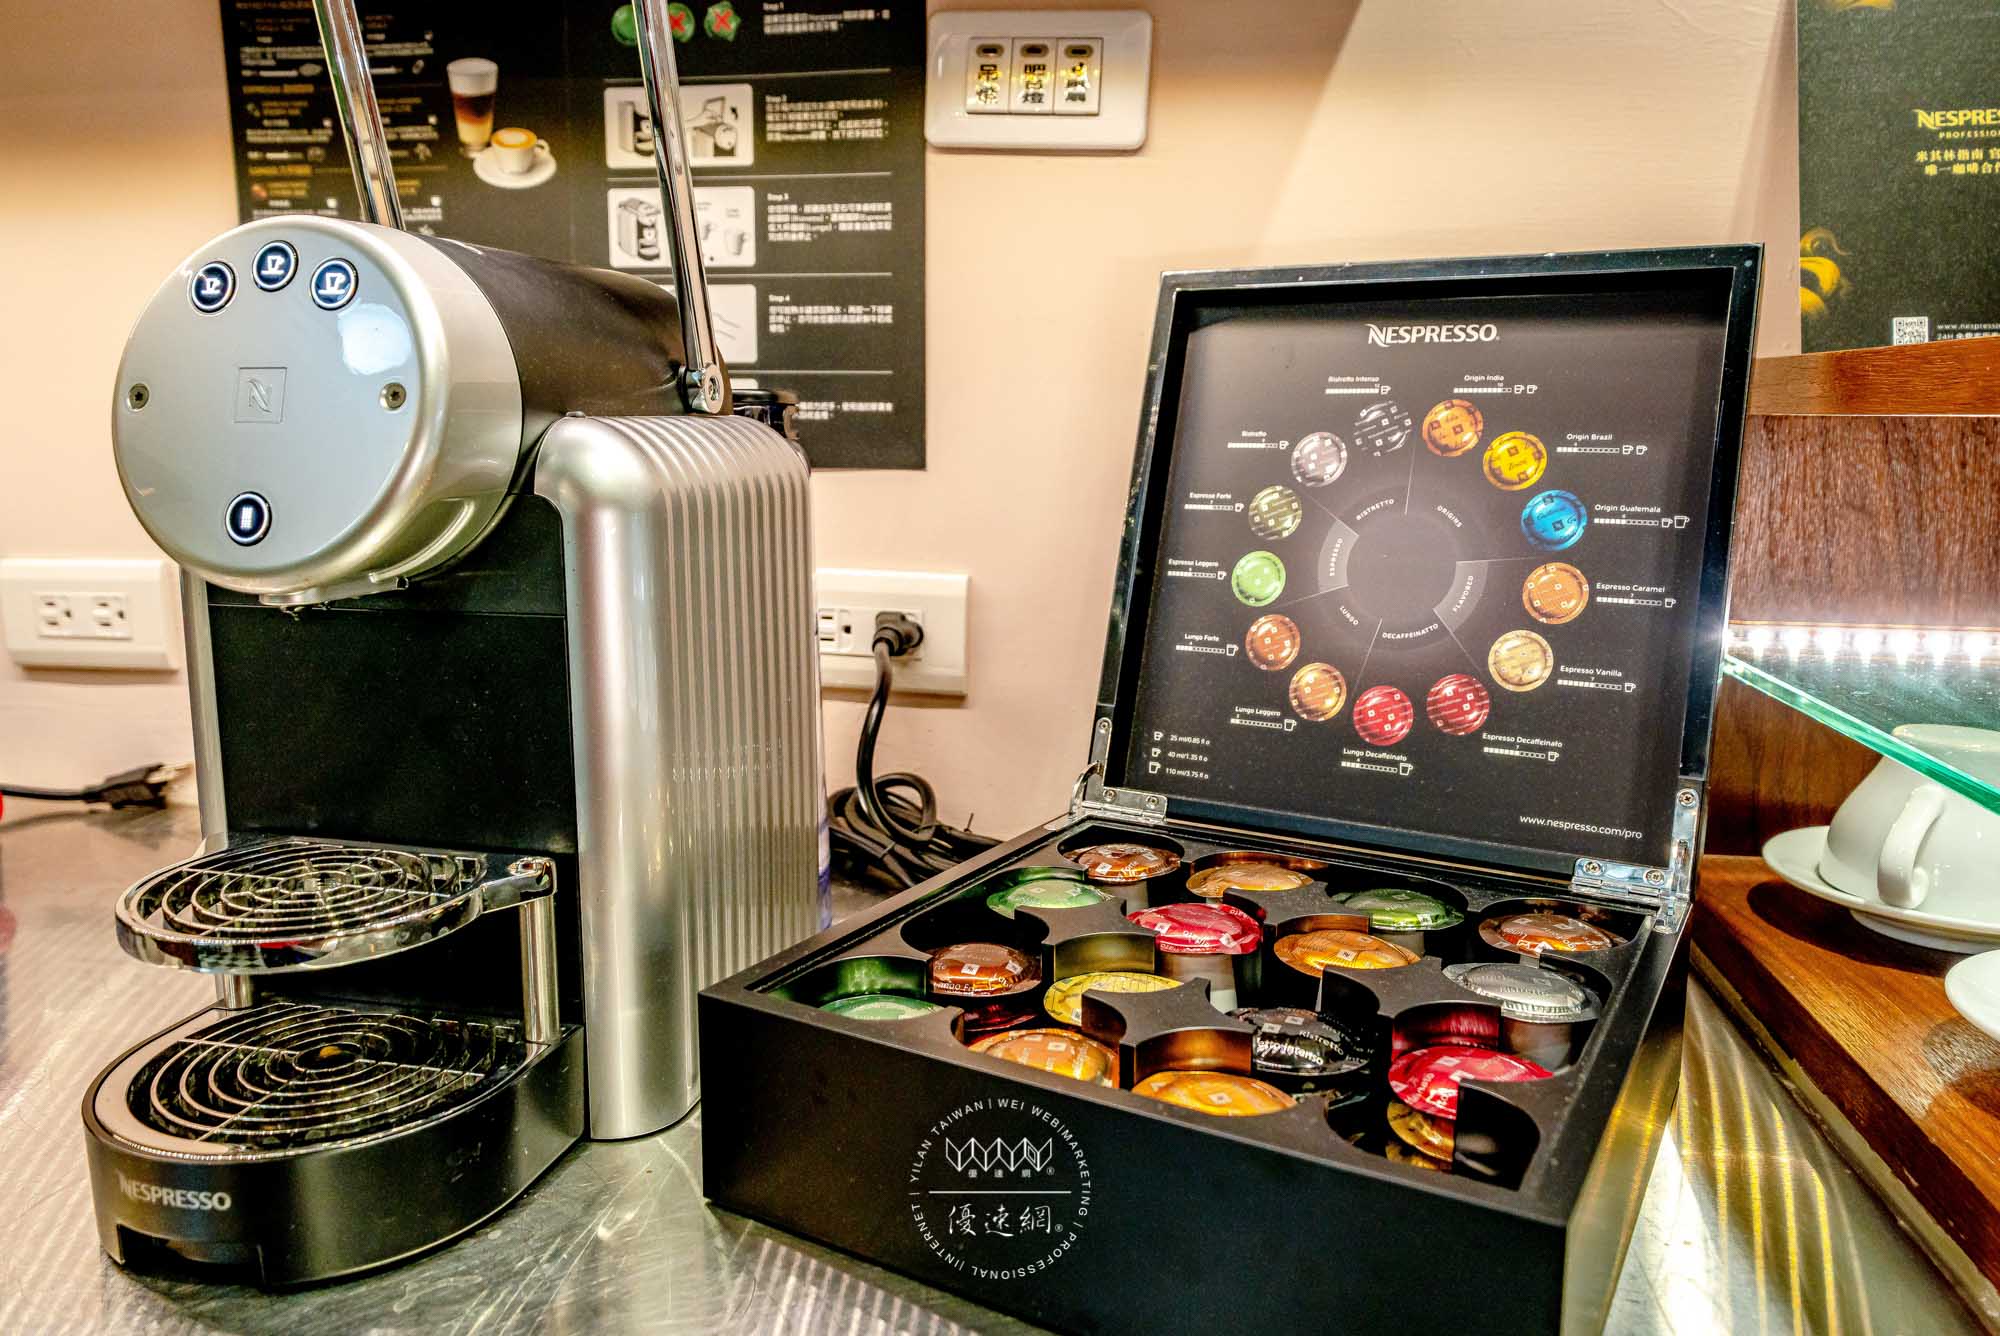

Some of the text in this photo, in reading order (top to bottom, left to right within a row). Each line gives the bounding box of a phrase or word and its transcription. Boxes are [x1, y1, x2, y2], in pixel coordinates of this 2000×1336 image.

[1364, 323, 1498, 347] NESPRESSO
[1464, 374, 1486, 382] Origin
[1566, 433, 1590, 441] Origin
[1594, 503, 1661, 513] Origin Guatemala
[1596, 582, 1665, 593] Espresso Caramel
[1560, 665, 1622, 677] Espresso Vanilla
[1482, 732, 1562, 748] Espresso Decaffeinato
[1343, 748, 1407, 762] Lungo Decaffeinato
[1519, 816, 1643, 840] www.nespresso.com/pro
[115, 1169, 232, 1211] NESPRESSO
